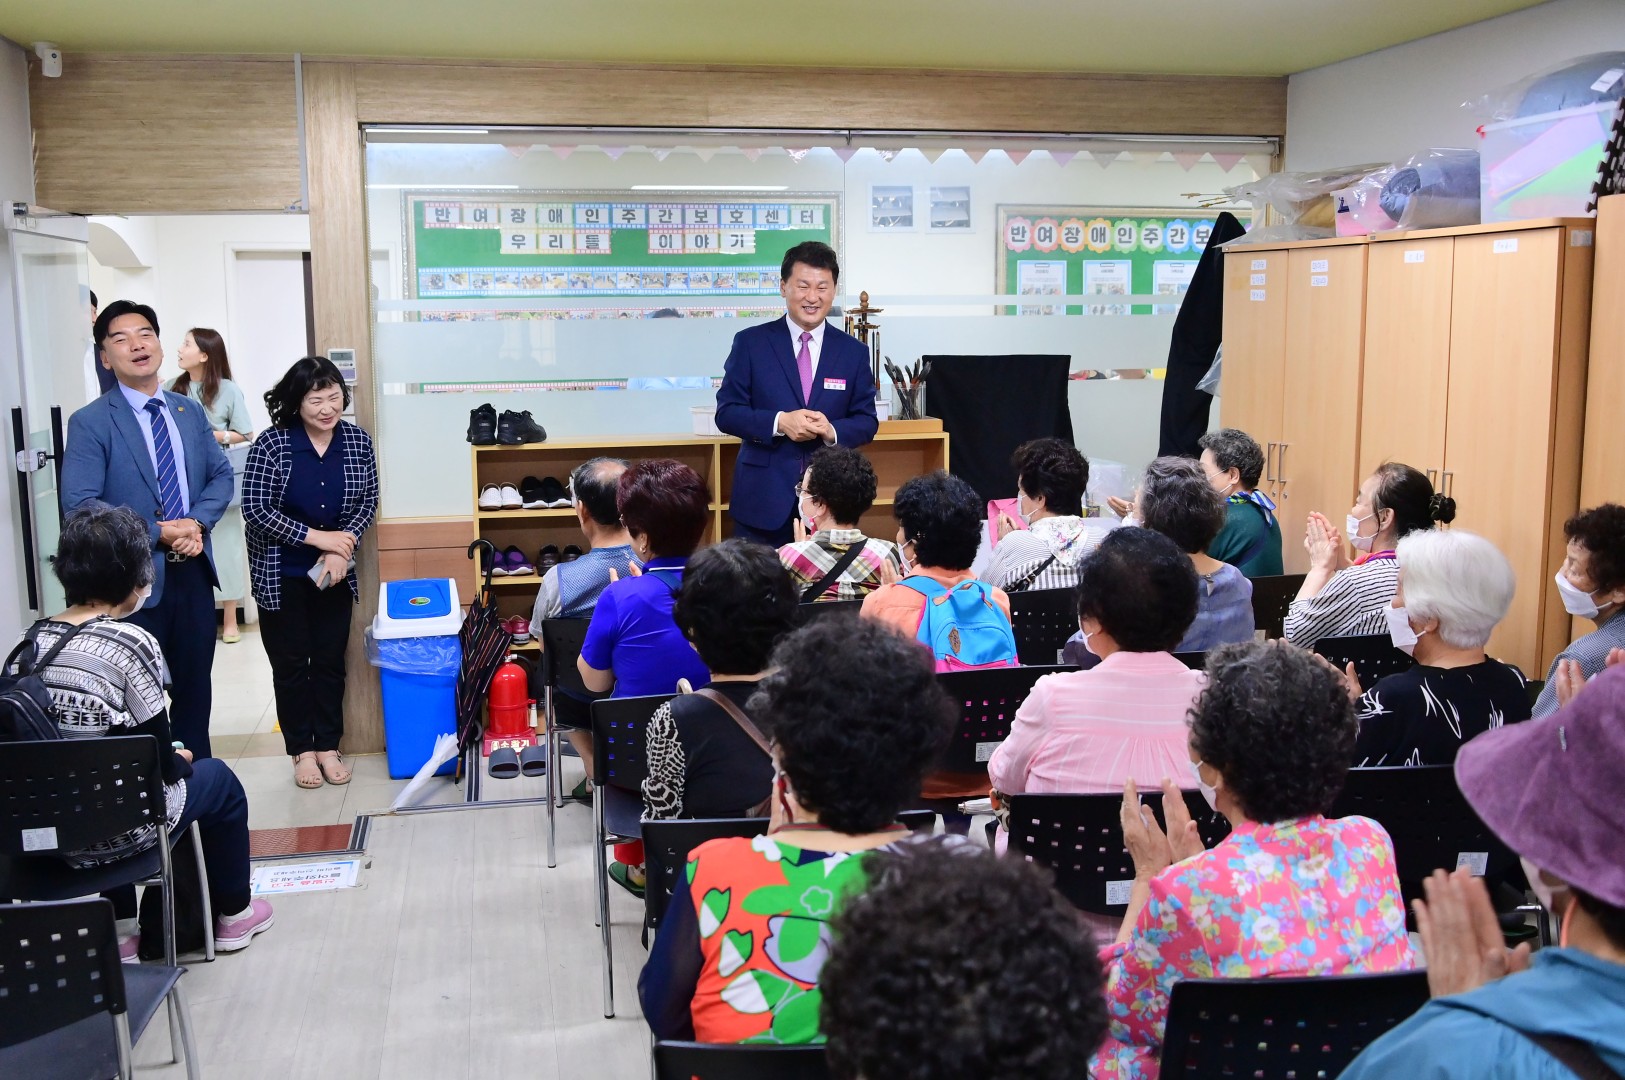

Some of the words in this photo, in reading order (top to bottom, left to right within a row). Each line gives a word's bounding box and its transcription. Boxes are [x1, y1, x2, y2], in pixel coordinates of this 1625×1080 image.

[435, 208, 814, 224] 반여장애인주간보호센터
[511, 234, 600, 250] 우리들
[658, 234, 744, 249] 이야기
[1010, 226, 1210, 244] 반여장애인주간보
